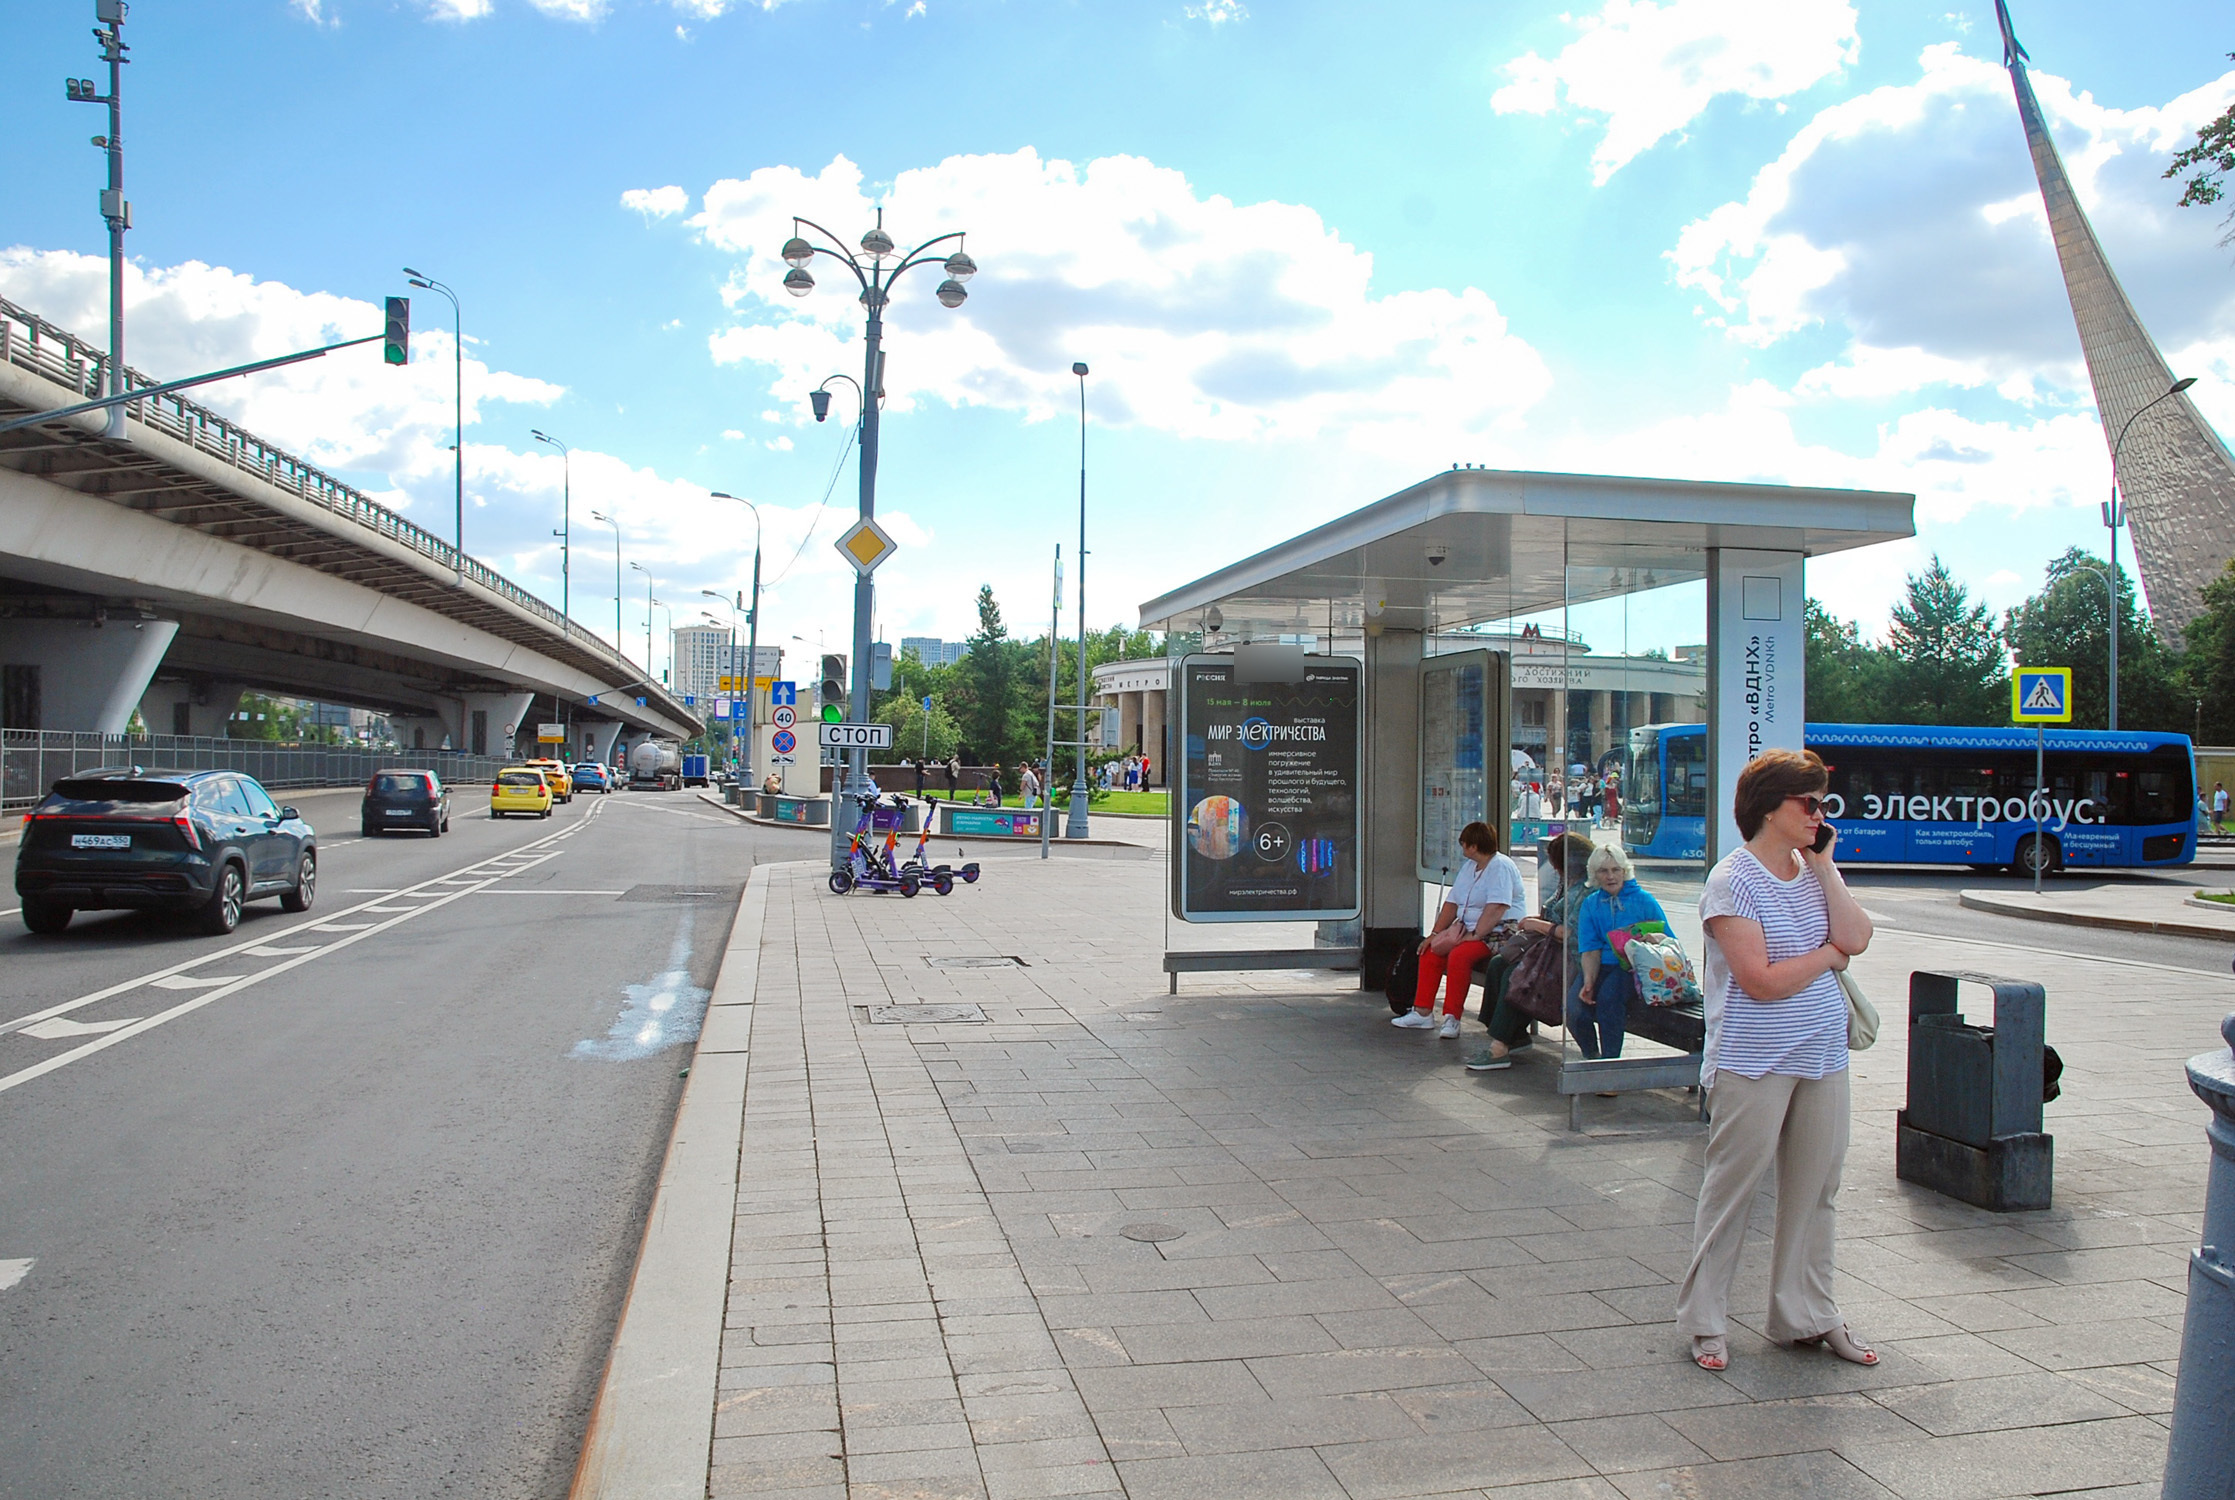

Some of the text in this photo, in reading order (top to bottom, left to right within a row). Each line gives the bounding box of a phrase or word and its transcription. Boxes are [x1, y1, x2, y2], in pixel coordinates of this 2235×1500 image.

[1524, 668, 1591, 677] ДОСТИЖНИЙ
[1119, 679, 1160, 688] МЕТРО
[1537, 676, 1583, 684] ХОЗЯЙВА
[1764, 636, 1775, 723] Metro VDNKh
[1207, 698, 1214, 706] 15
[1745, 635, 1762, 763] етро «ВДНХ»
[777, 713, 792, 723] 40
[829, 726, 881, 745] СТОП
[1208, 726, 1232, 741] МИР
[1268, 751, 1317, 759] иммерсивное
[1274, 769, 1323, 777] удивительный
[1311, 778, 1347, 786] будущего,
[1268, 787, 1311, 795] технологий,
[1862, 787, 2106, 832] электробус.
[1853, 828, 1886, 836] батареи
[1931, 830, 1994, 839] электромобиль,
[2063, 832, 2120, 840] Маневренный
[1259, 833, 1284, 851] 6+
[1943, 838, 1974, 847] автобус
[2069, 841, 2116, 850] бесшумный
[1229, 888, 1298, 896] мирэлектричества.рф
